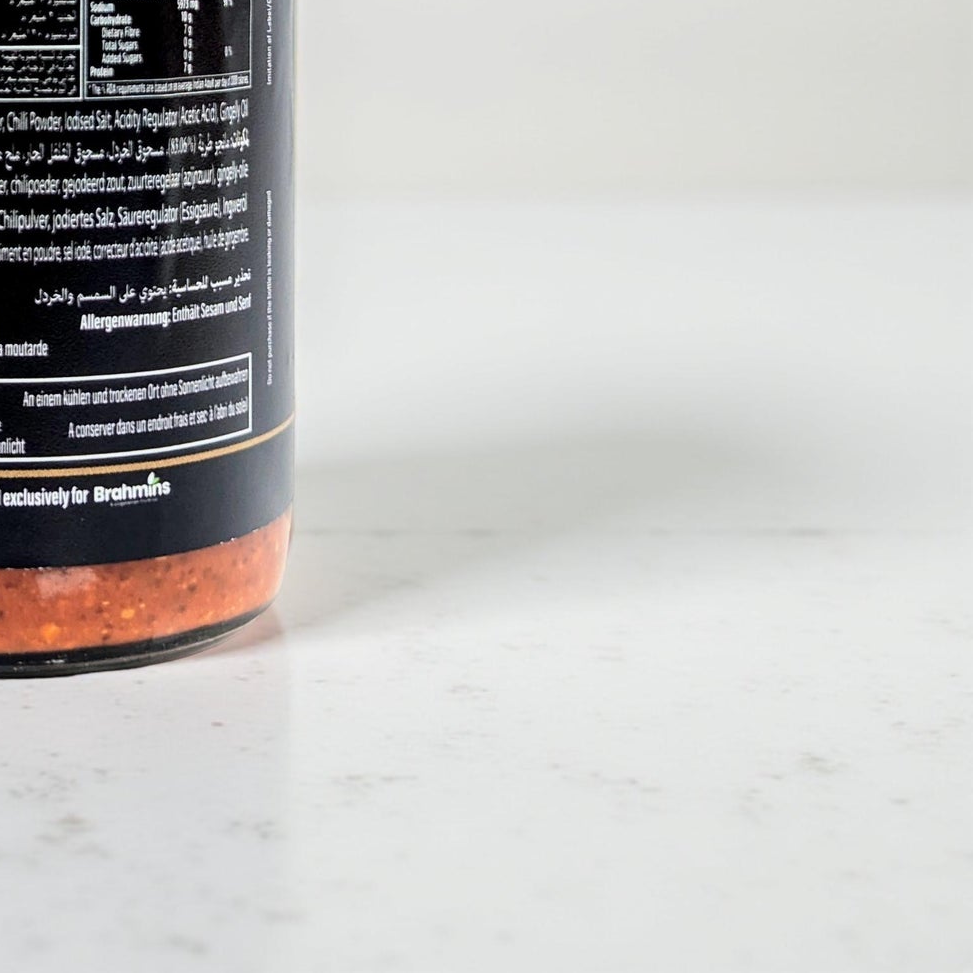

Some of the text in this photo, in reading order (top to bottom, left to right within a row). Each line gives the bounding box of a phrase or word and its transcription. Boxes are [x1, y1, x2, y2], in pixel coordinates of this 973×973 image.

[90, 1, 115, 13] Sodium
[90, 14, 132, 27] Carbohydrate
[101, 27, 140, 39] Dietary Fibre
[266, 35, 272, 44] of
[102, 40, 139, 51] Total Sugars
[102, 52, 143, 63] Added Sugars
[90, 66, 115, 77] Protein
[30, 111, 63, 133] Powder,
[142, 107, 177, 133] Regulator
[52, 208, 93, 234] jodiertes
[34, 285, 167, 307] يحتوي على السمسم والخردل
[80, 293, 251, 333] Allergenwarnung: Enthält Sesam und Senf
[5, 339, 49, 357] moutarde
[266, 373, 272, 385] Do
[23, 375, 215, 407] An einem kühlen und trockenen Ort ohne Sonnenlicht
[68, 412, 196, 439] A conserver dans un endroit frais et
[3, 487, 69, 509] exclusively
[71, 486, 89, 504] for
[93, 476, 171, 503] Brahmins
